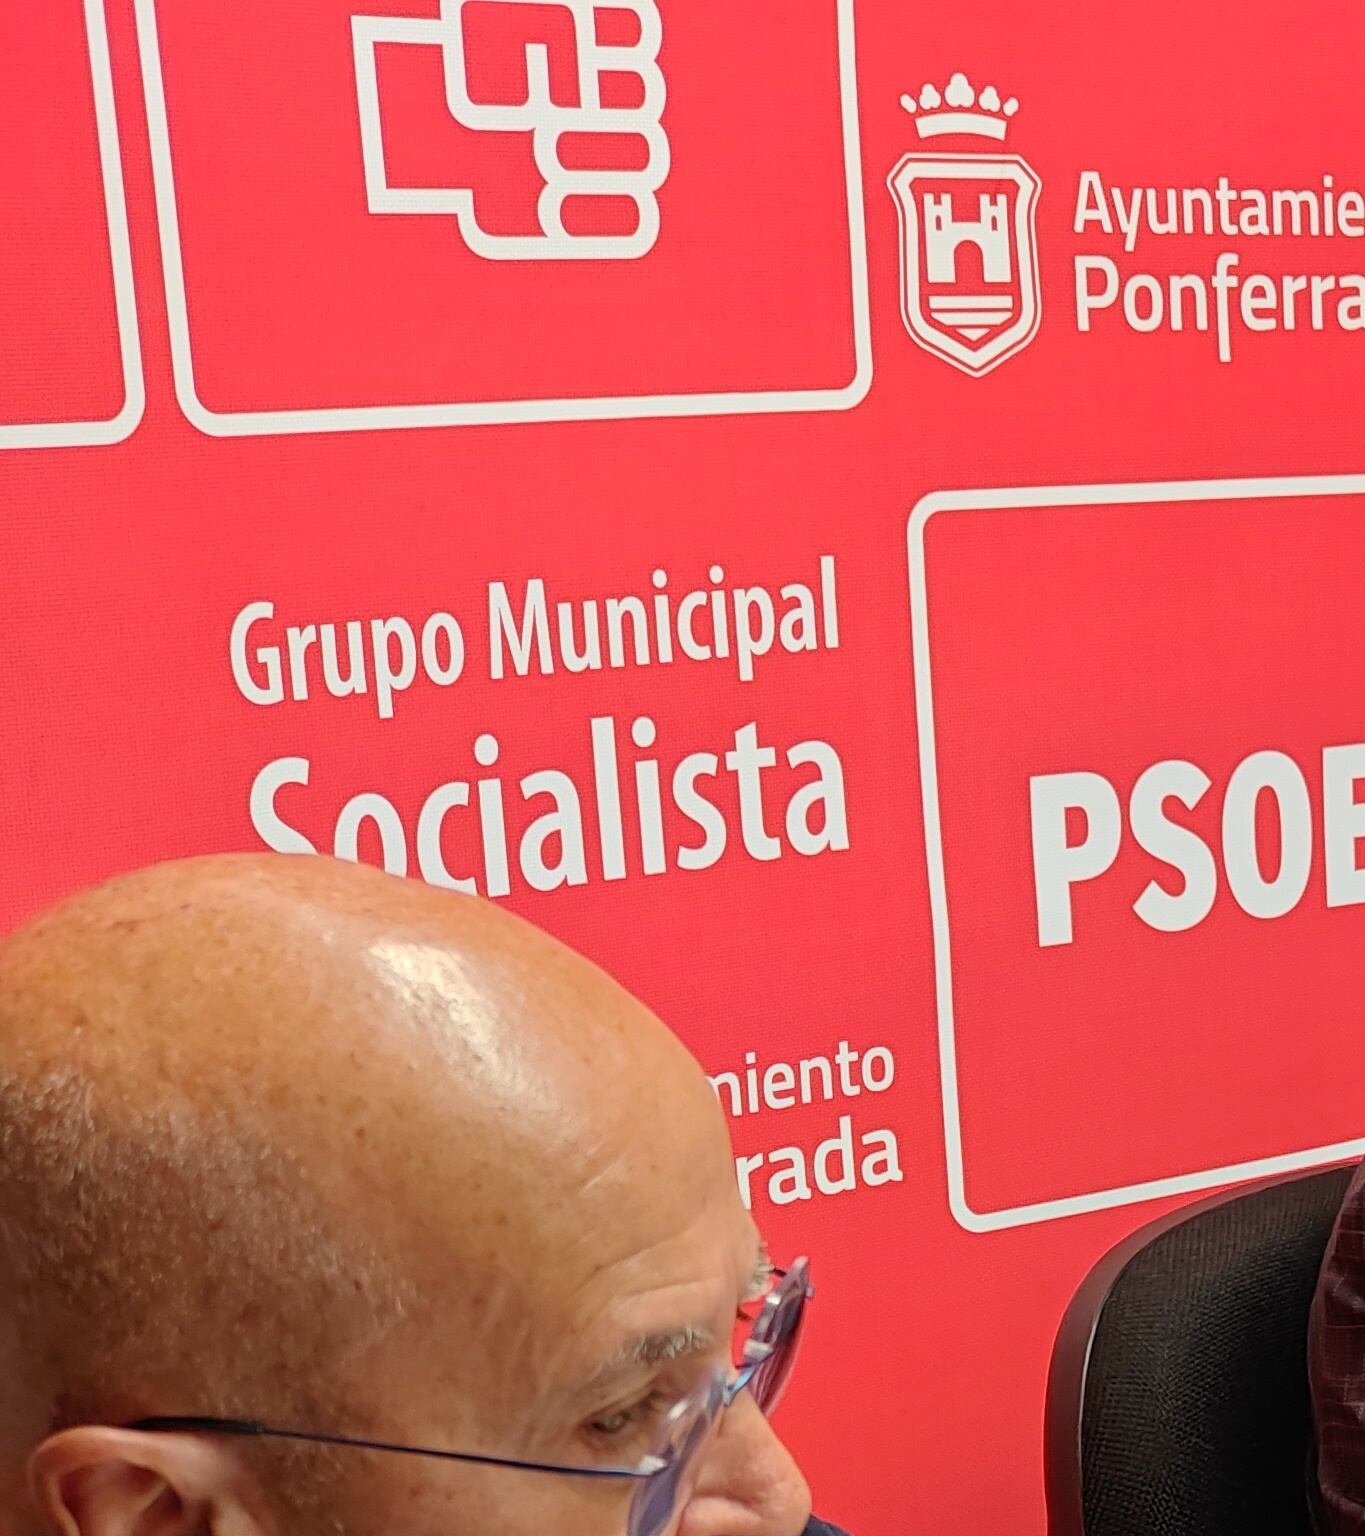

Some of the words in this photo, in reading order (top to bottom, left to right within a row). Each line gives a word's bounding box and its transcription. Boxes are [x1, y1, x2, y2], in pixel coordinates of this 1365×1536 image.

[231, 602, 464, 718] Grupo
[489, 556, 838, 681] Municipal
[249, 716, 851, 898] Socialista
